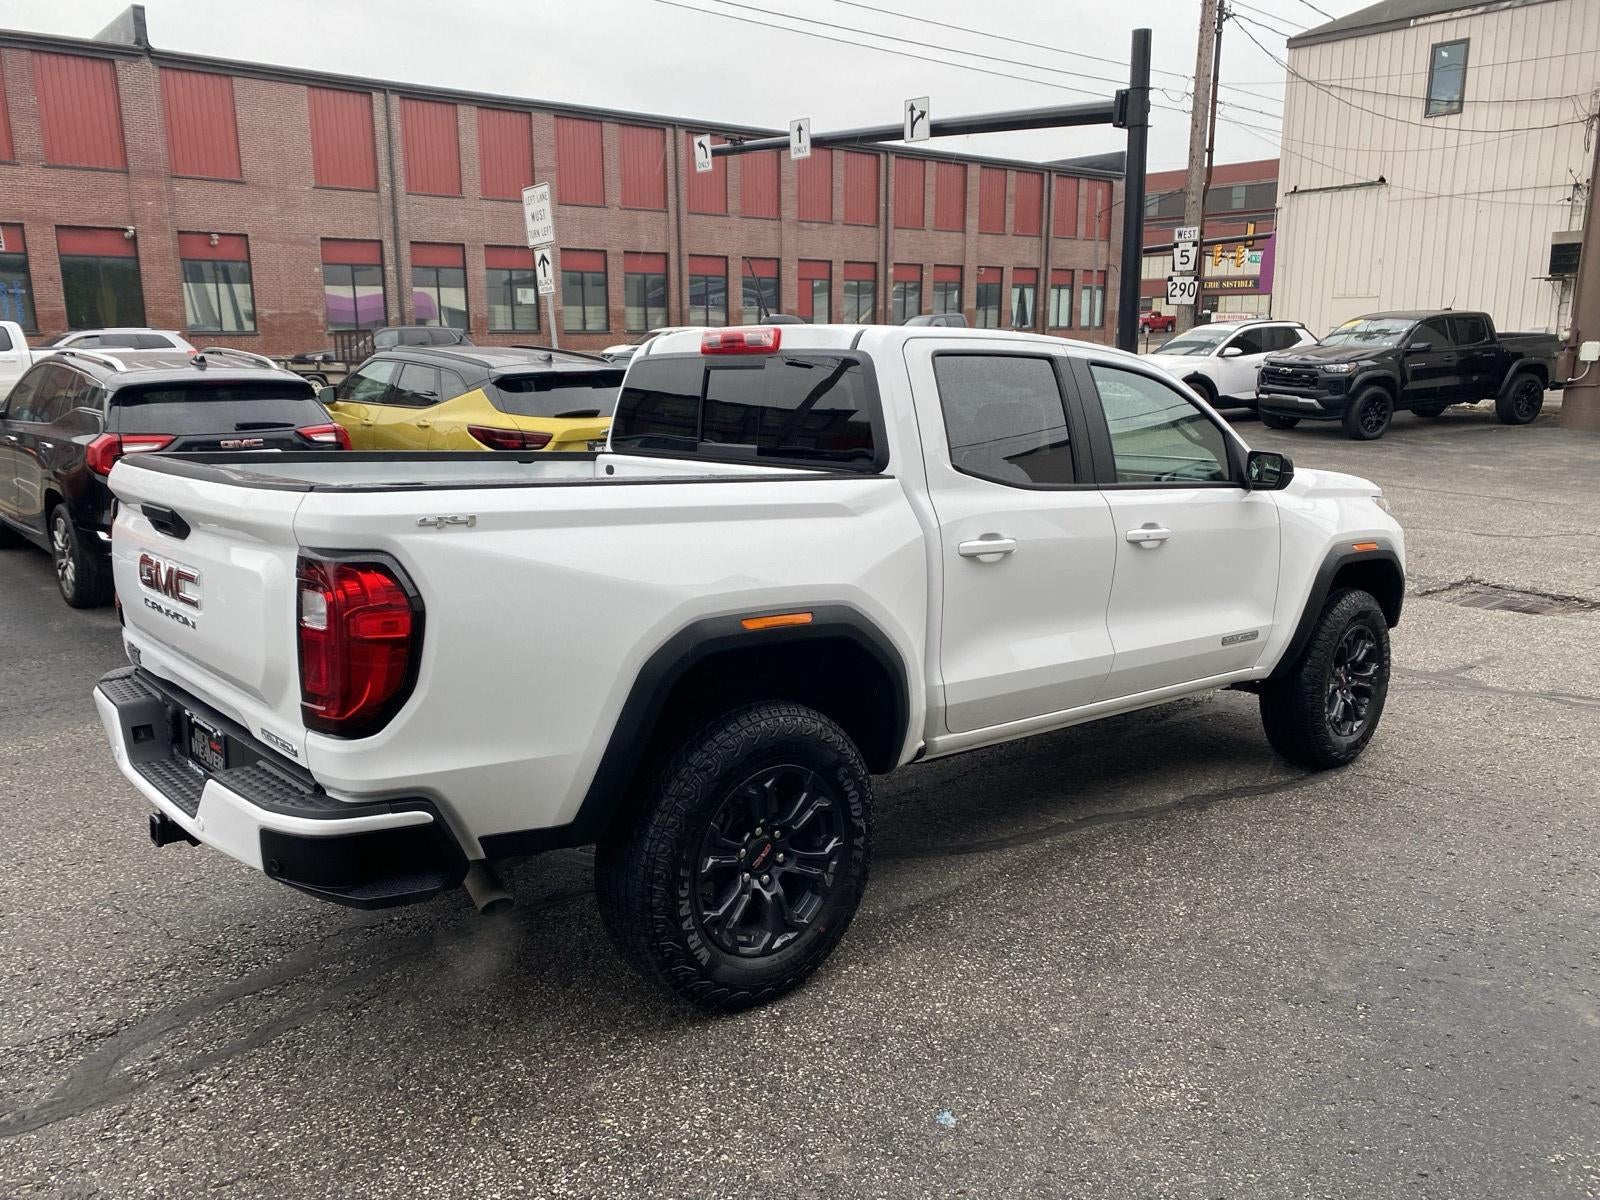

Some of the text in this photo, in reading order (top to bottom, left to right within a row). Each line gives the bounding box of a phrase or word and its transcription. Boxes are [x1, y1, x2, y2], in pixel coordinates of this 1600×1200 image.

[793, 145, 807, 155] ONLY
[698, 161, 710, 170] ONLY
[525, 191, 548, 206] LEFT LANE
[530, 208, 546, 222] MUST
[529, 225, 552, 240] TURN LEFT
[1177, 229, 1197, 240] WEST
[1180, 250, 1190, 265] 5
[1169, 282, 1196, 297] 290
[220, 438, 264, 449] GMC
[139, 553, 201, 609] GMC
[144, 597, 197, 630] CANYON
[837, 766, 866, 886] GOODYEA
